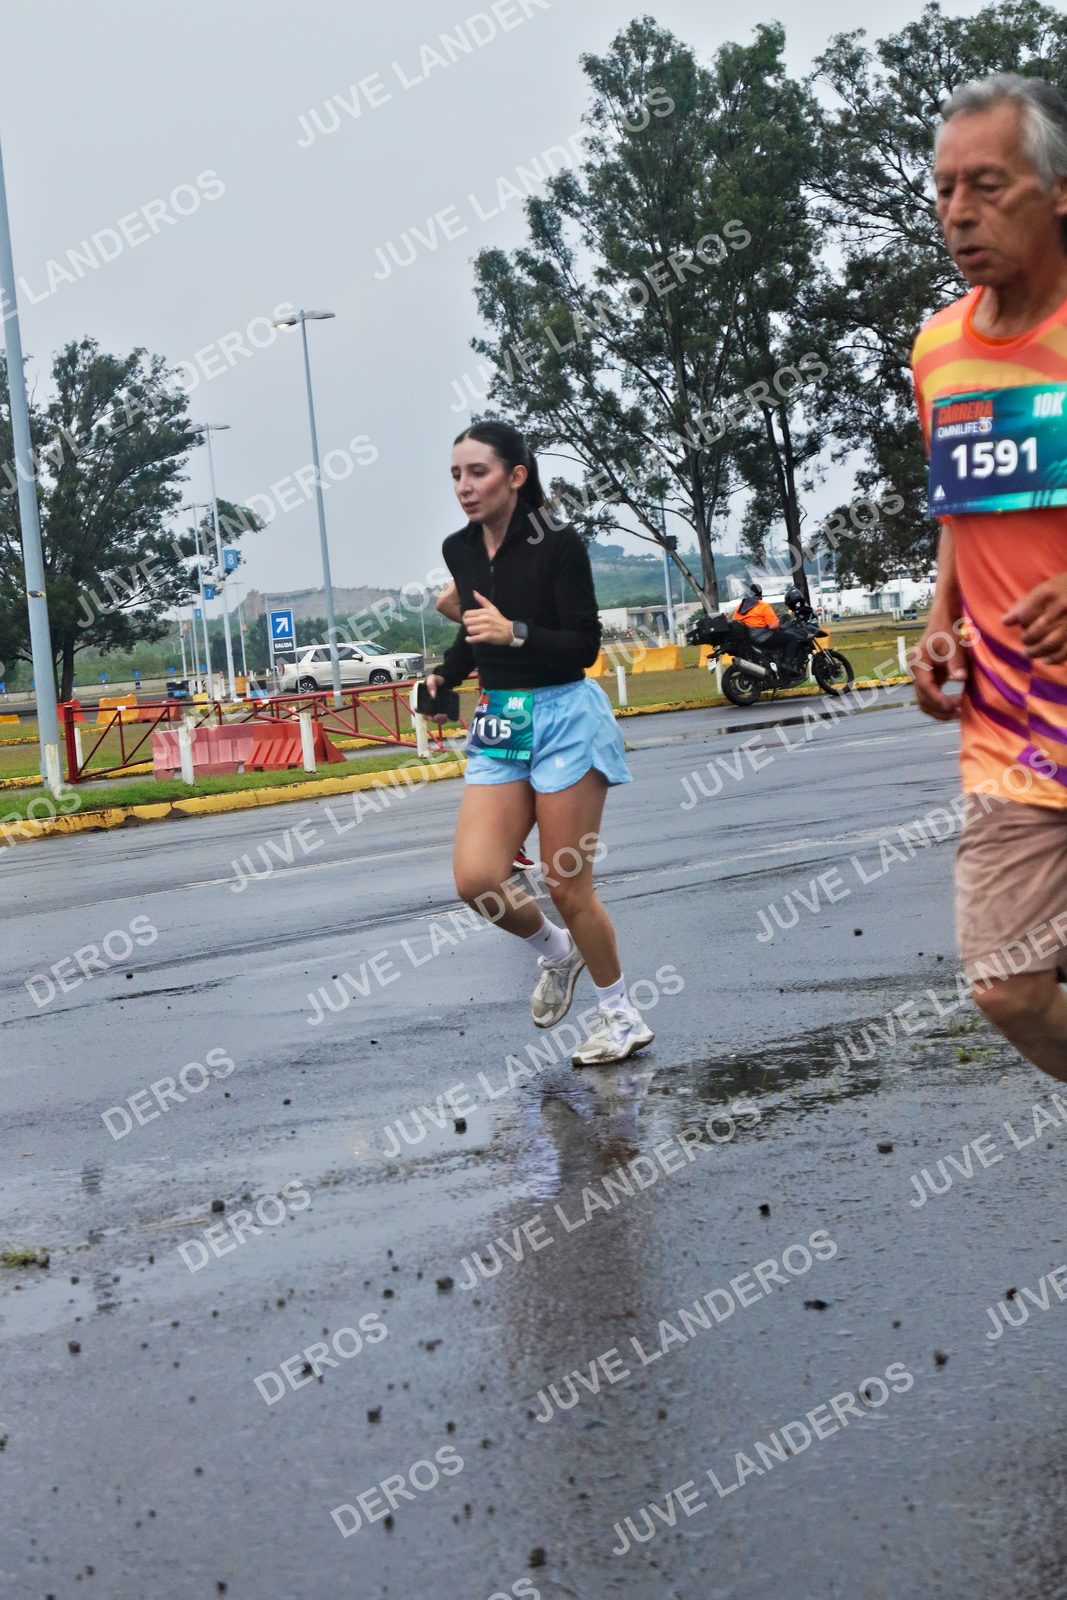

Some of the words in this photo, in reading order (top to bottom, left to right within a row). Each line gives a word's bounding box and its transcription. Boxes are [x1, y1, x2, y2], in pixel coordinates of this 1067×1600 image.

[1032, 391, 1066, 417] 10K
[951, 436, 1038, 479] 1591
[227, 553, 234, 565] 8
[274, 641, 293, 650] SALIDA
[508, 696, 526, 710] 10K
